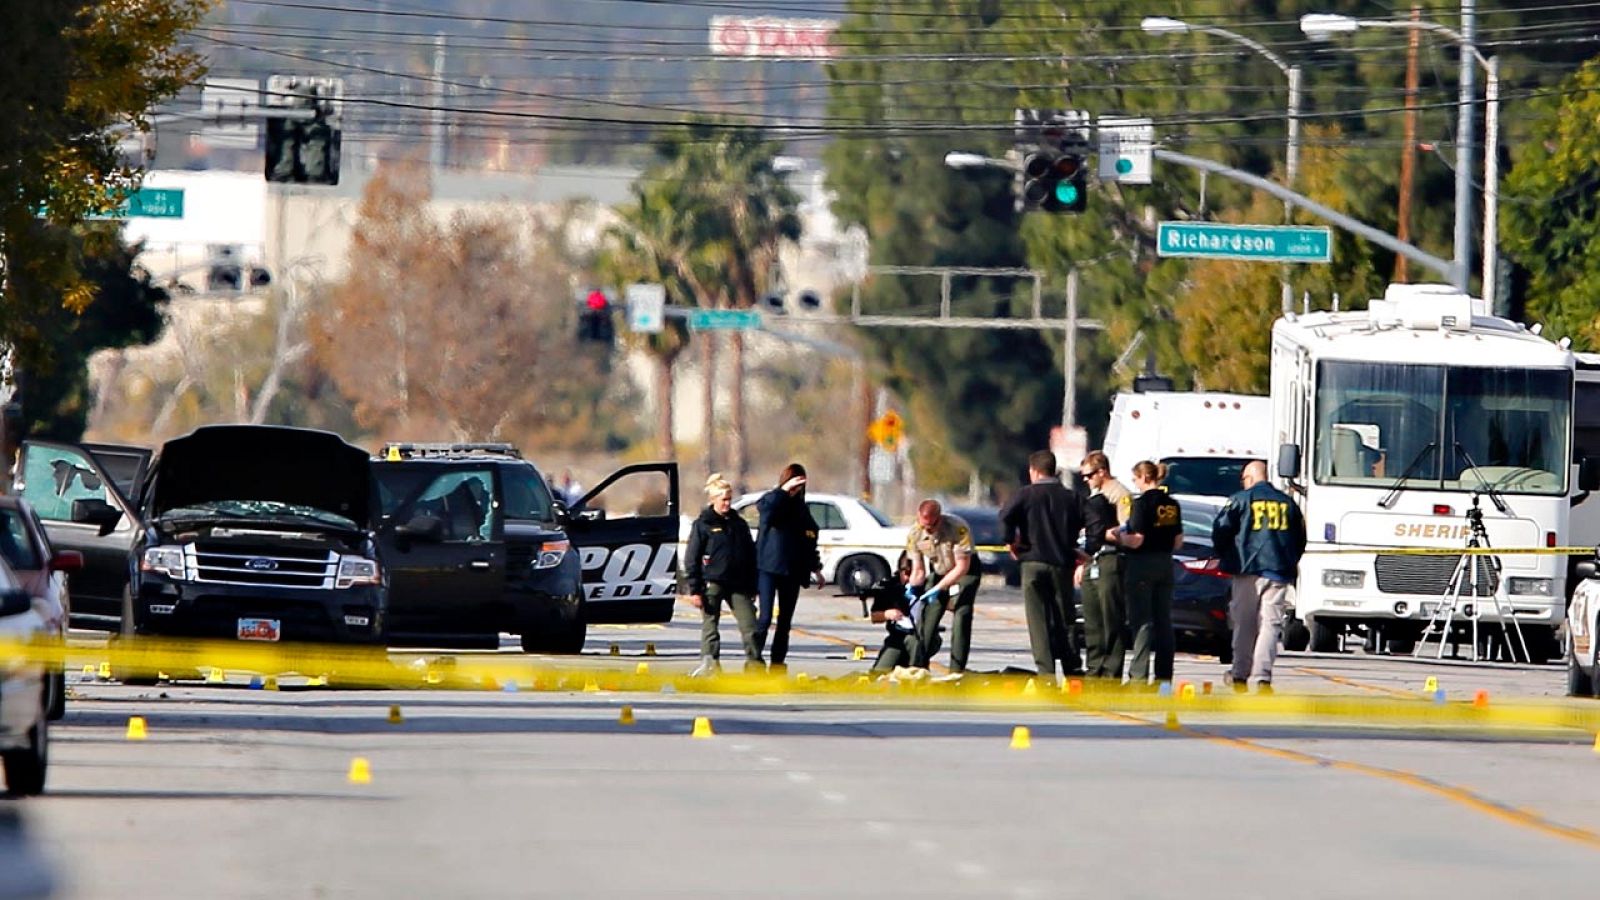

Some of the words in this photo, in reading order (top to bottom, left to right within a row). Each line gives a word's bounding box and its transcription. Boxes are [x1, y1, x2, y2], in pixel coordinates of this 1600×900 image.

[1168, 229, 1276, 252] Richardson
[1251, 500, 1289, 531] FBI
[1394, 523, 1476, 540] SHERIF
[577, 543, 678, 583] POL
